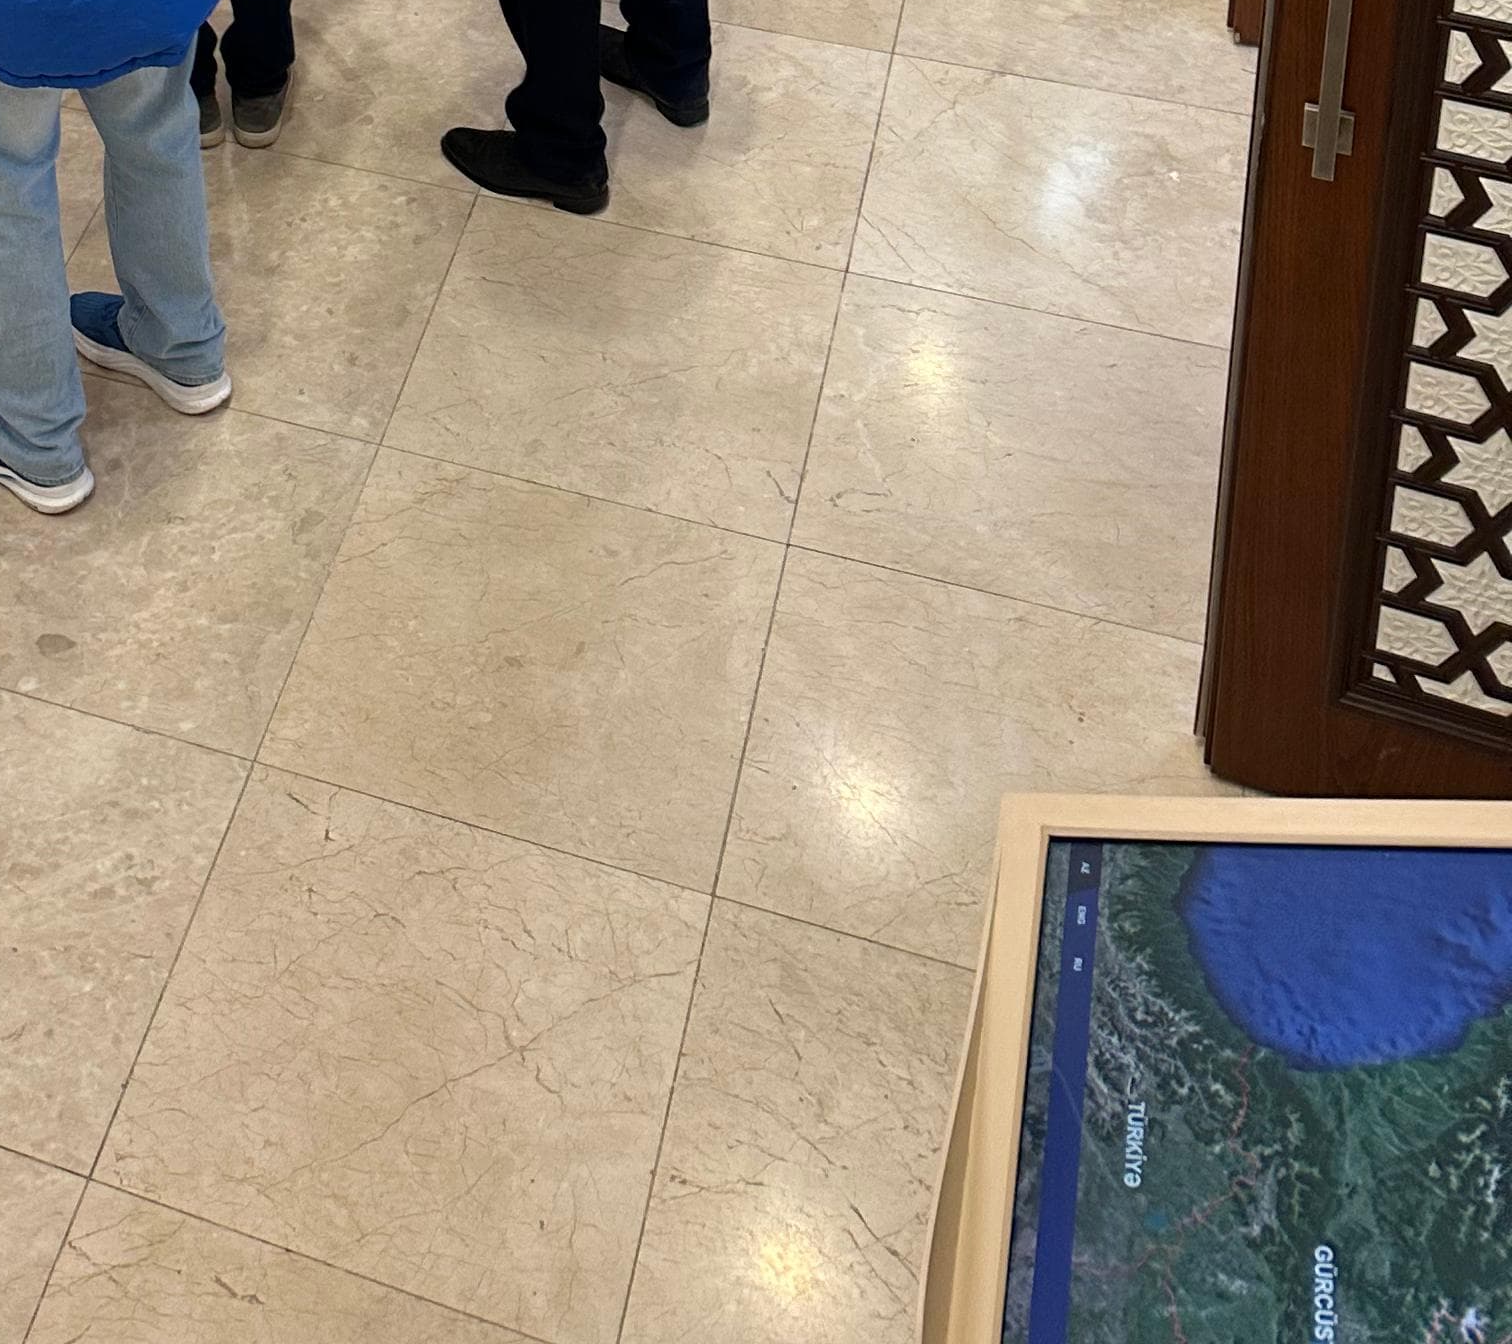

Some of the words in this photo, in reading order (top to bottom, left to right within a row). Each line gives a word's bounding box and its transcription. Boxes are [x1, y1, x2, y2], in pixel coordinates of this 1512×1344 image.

[1080, 861, 1090, 874] AZ
[1077, 905, 1087, 925] ENG
[1073, 957, 1083, 972] RU
[1123, 1101, 1148, 1188] TÜRKİYƏ
[1314, 1245, 1338, 1344] GÜRCÜS
